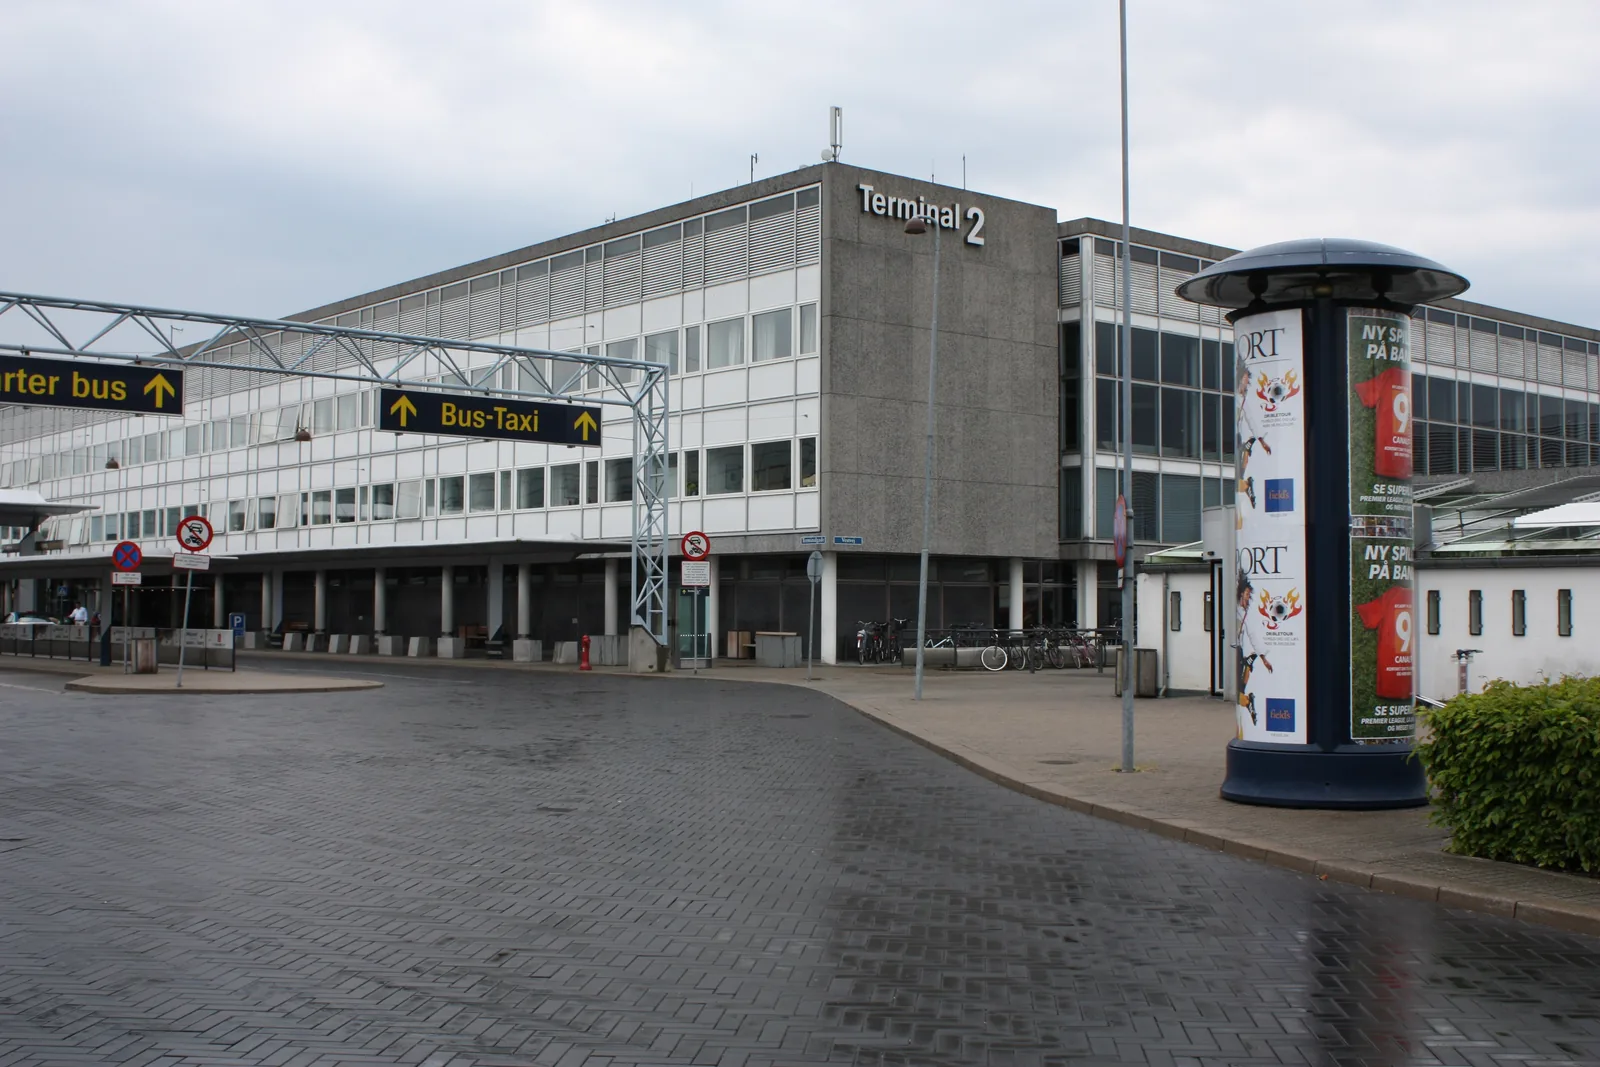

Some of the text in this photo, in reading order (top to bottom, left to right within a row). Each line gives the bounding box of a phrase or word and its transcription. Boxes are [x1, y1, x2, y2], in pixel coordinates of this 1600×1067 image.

[858, 183, 985, 246] Terminal 2
[1362, 324, 1387, 341] NY
[1237, 327, 1285, 361] ORT
[1366, 340, 1388, 360] PÅ
[0, 368, 127, 401] rter bus
[441, 402, 539, 432] Bus-Taxi
[1393, 392, 1409, 434] 9
[1373, 484, 1386, 494] SE
[1364, 544, 1390, 561] NY
[1368, 560, 1390, 580] PÅ
[234, 615, 242, 627] P
[1395, 610, 1412, 653] 9
[1374, 705, 1387, 716] SE
[1361, 717, 1388, 725] PREMIER
